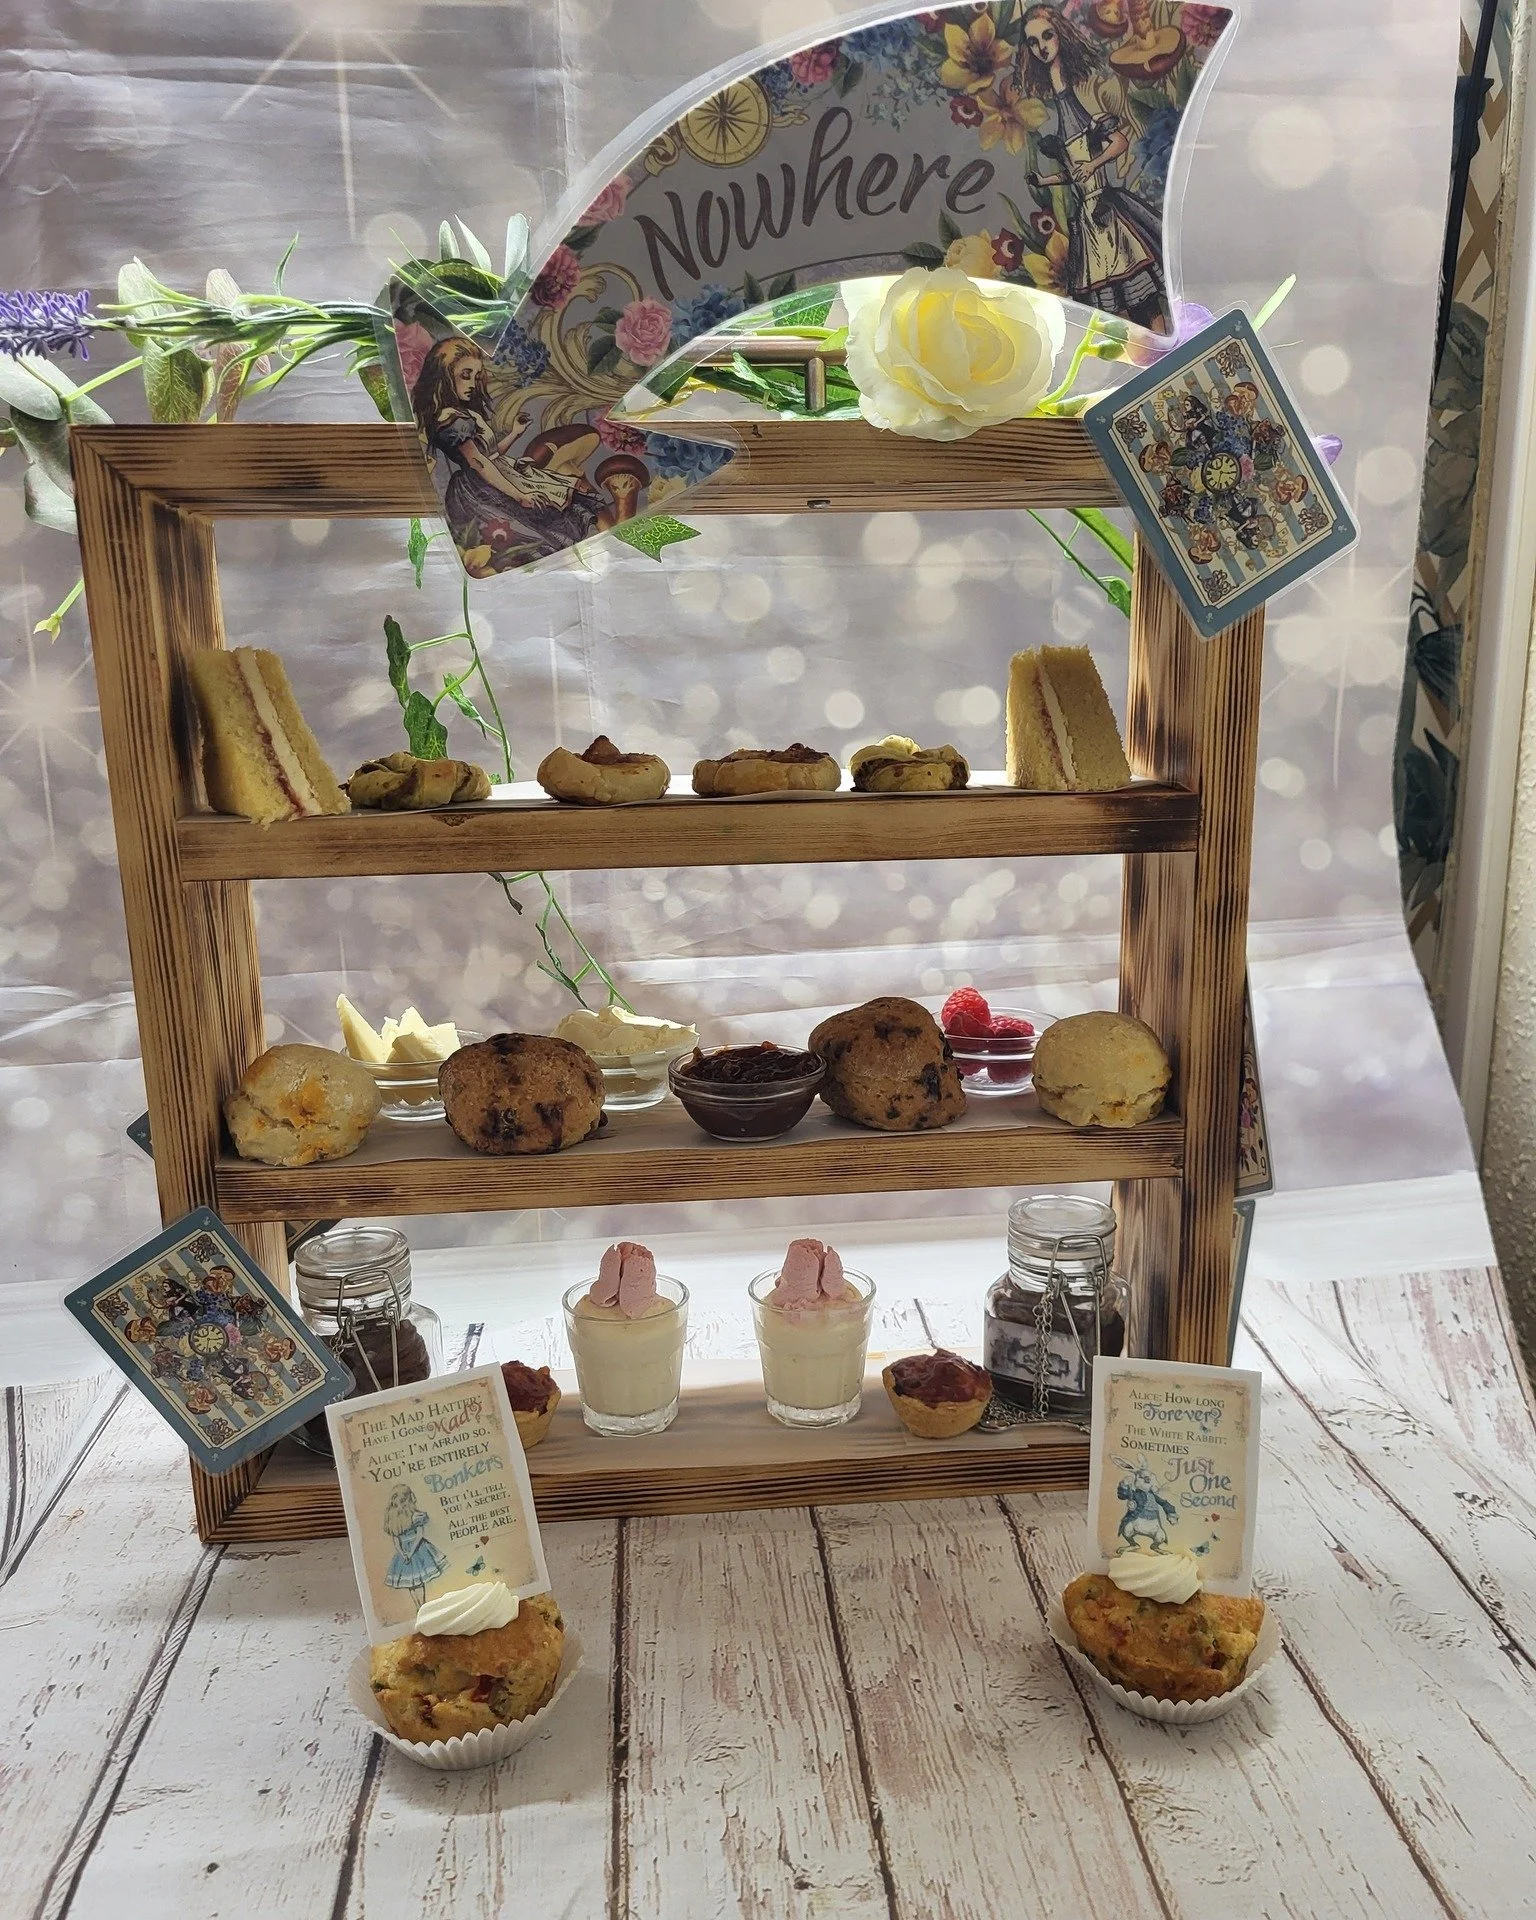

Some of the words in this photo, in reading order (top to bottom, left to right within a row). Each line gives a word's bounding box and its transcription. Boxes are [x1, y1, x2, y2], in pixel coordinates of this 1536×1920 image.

[633, 106, 996, 300] Nowhere
[1165, 1392, 1194, 1404] HOW
[1196, 1398, 1225, 1408] LONG
[358, 1420, 388, 1435] THE
[390, 1411, 425, 1427] MAD
[362, 1435, 389, 1448] HAVE
[391, 1430, 396, 1440] I
[398, 1424, 427, 1438] GONE
[426, 1402, 483, 1440] Mad?
[1133, 1402, 1143, 1410] IS
[1143, 1402, 1222, 1427] Forever?
[408, 1443, 428, 1456] I'M
[432, 1432, 470, 1450] AFRAID
[1125, 1424, 1146, 1436] THE
[1149, 1427, 1183, 1440] WHITE
[1121, 1436, 1189, 1455] SOMETIMES
[368, 1461, 426, 1482] YOU'RE
[429, 1441, 490, 1467] ENTIRELY
[423, 1455, 503, 1493] Bonkers
[1164, 1457, 1215, 1482] Just
[440, 1495, 460, 1507] BUT
[484, 1482, 506, 1494] TELL
[1189, 1474, 1232, 1494] One
[443, 1505, 462, 1515] YOU
[1180, 1492, 1238, 1510] Second
[449, 1520, 468, 1530] ALL
[469, 1513, 488, 1523] THE
[489, 1505, 511, 1518] BEST
[449, 1522, 489, 1541] PEOPLE
[492, 1515, 517, 1528] ARE.
